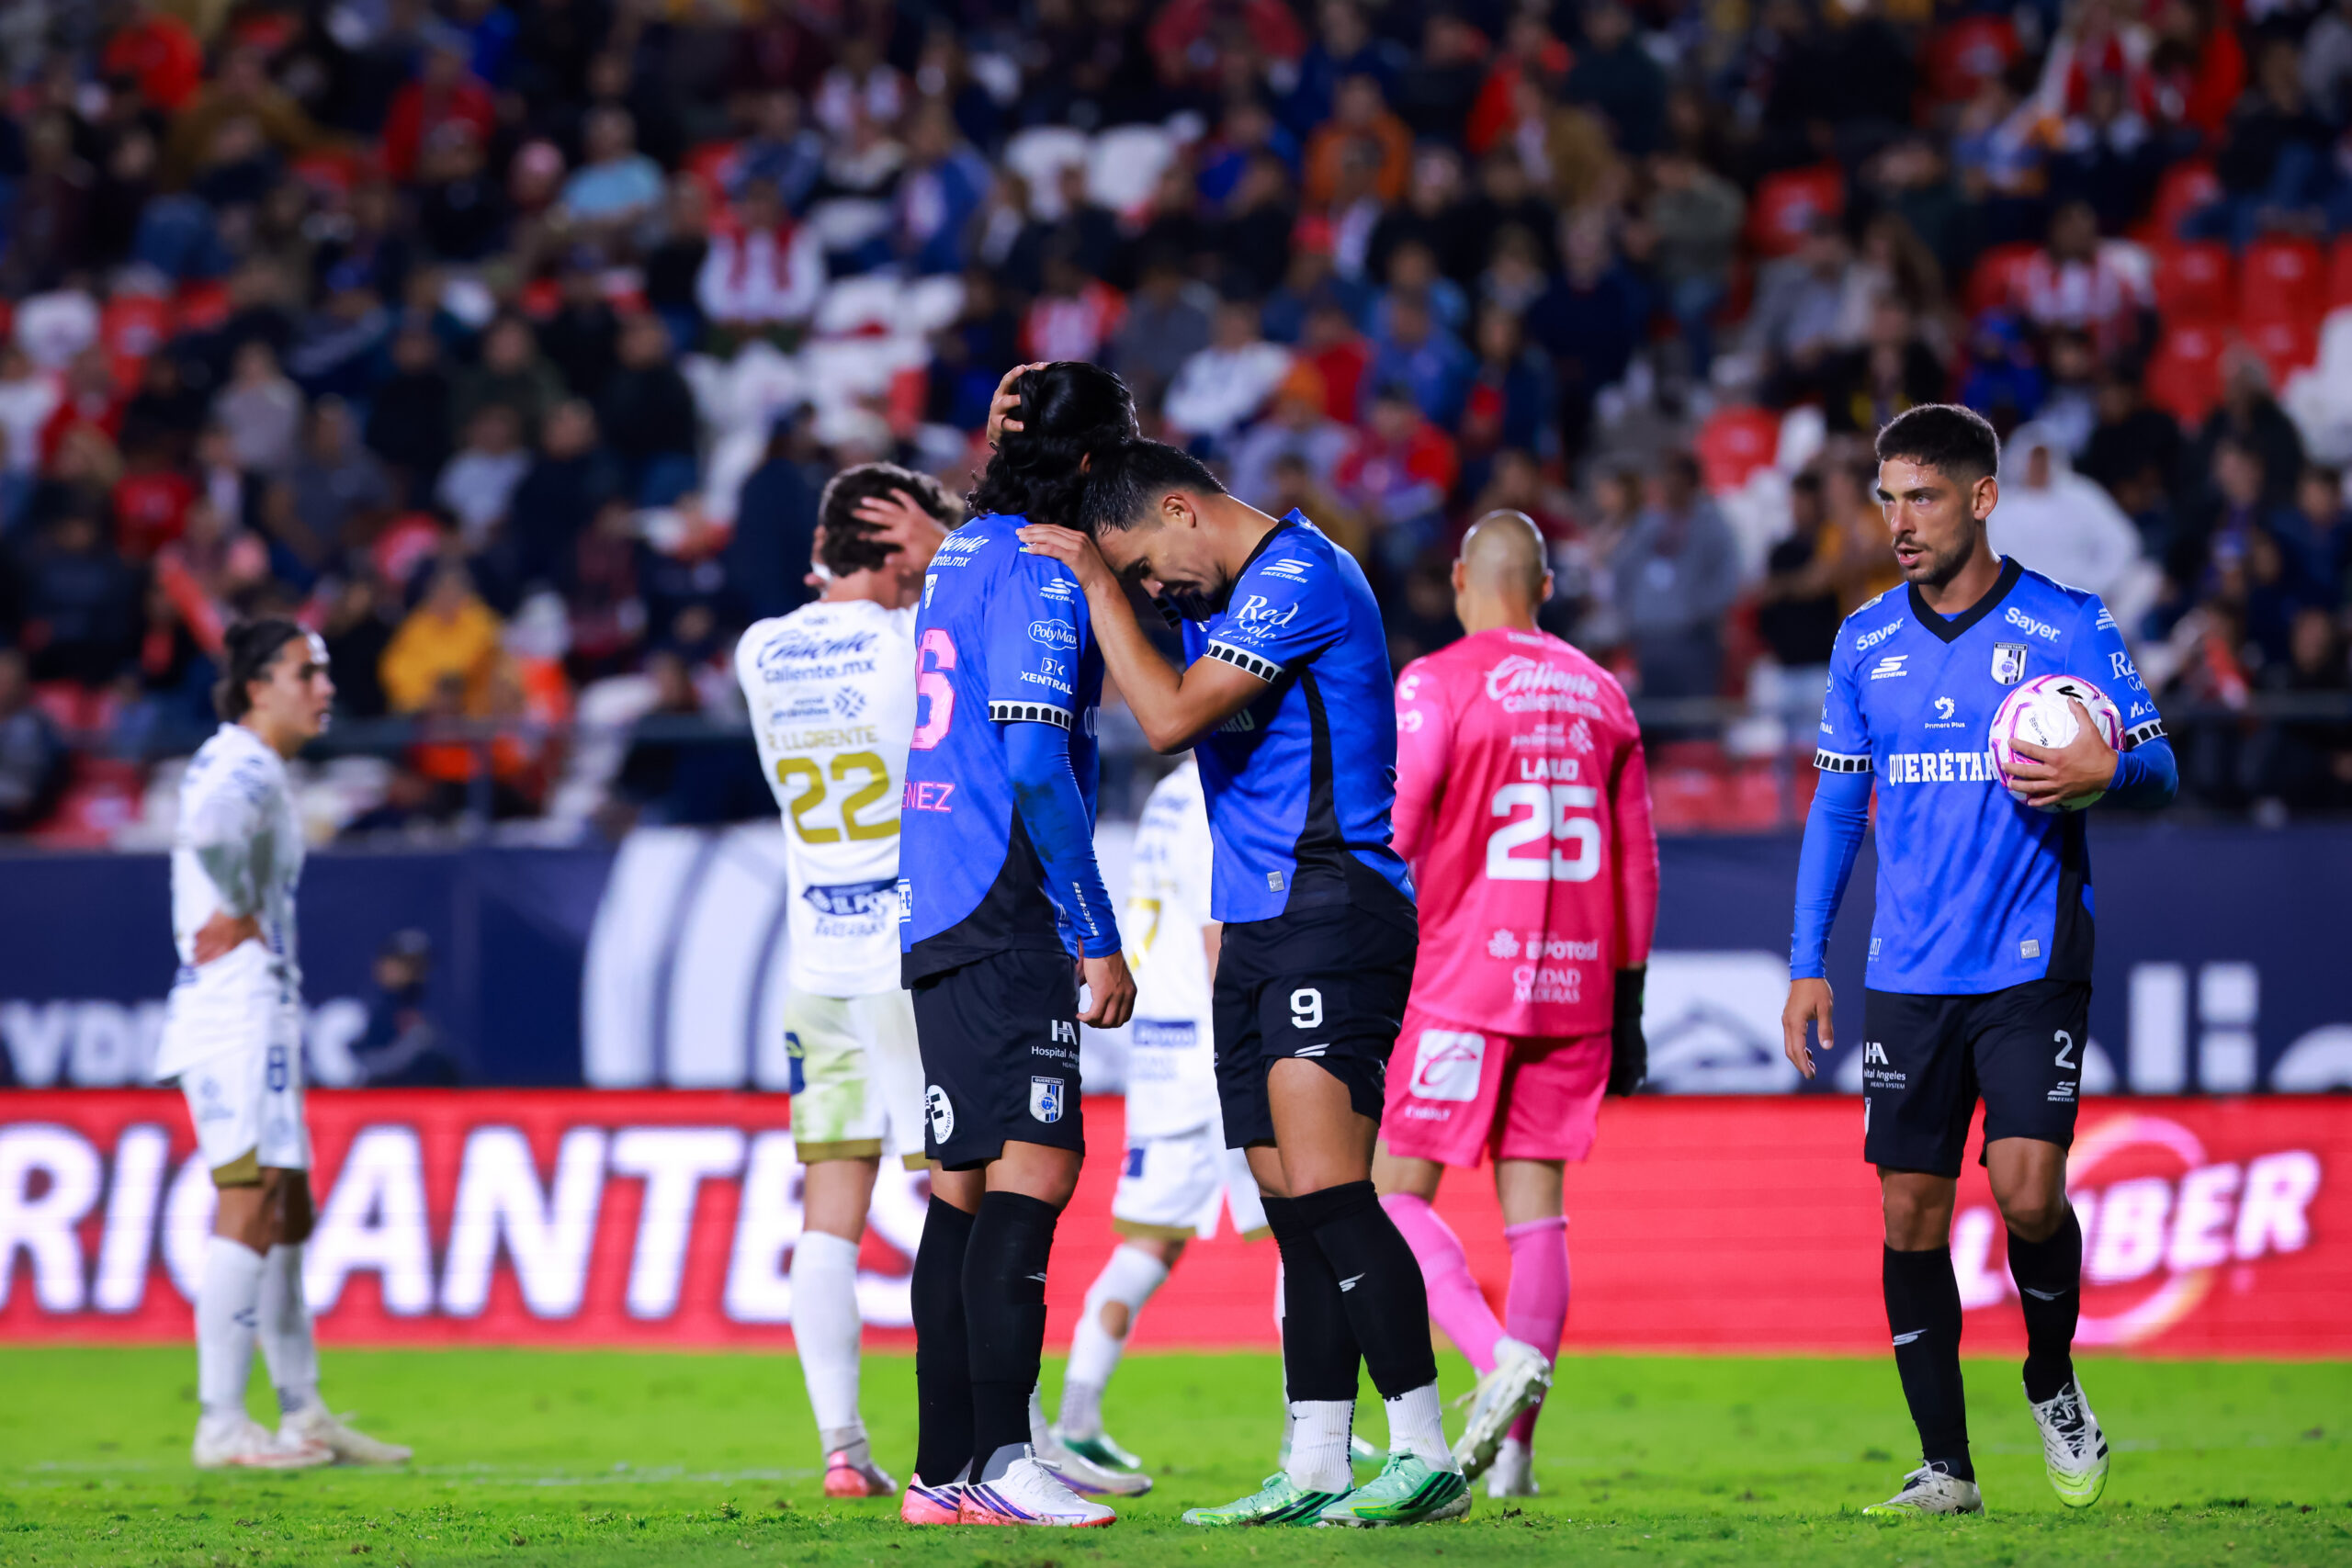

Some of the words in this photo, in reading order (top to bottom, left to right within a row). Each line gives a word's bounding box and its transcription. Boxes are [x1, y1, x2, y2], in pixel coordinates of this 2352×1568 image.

[939, 531, 989, 555] liente
[930, 554, 972, 568] ente.mx
[1259, 570, 1308, 583] SKECHERS
[1235, 594, 1299, 629] Red
[1033, 623, 1078, 645] PolyMax
[1871, 671, 1908, 681] SKECHERS
[2108, 650, 2137, 681] Re
[1020, 671, 1073, 695] XENTRAL
[1889, 749, 1998, 786] QUERÉTAR
[776, 751, 899, 844] 22
[1485, 783, 1600, 883] 25
[1290, 987, 1323, 1029] 9
[1031, 1045, 1067, 1059] Hospital
[2053, 1029, 2076, 1069] 2
[1876, 1069, 1906, 1082] Angeles
[1953, 1149, 2322, 1311] LBER
